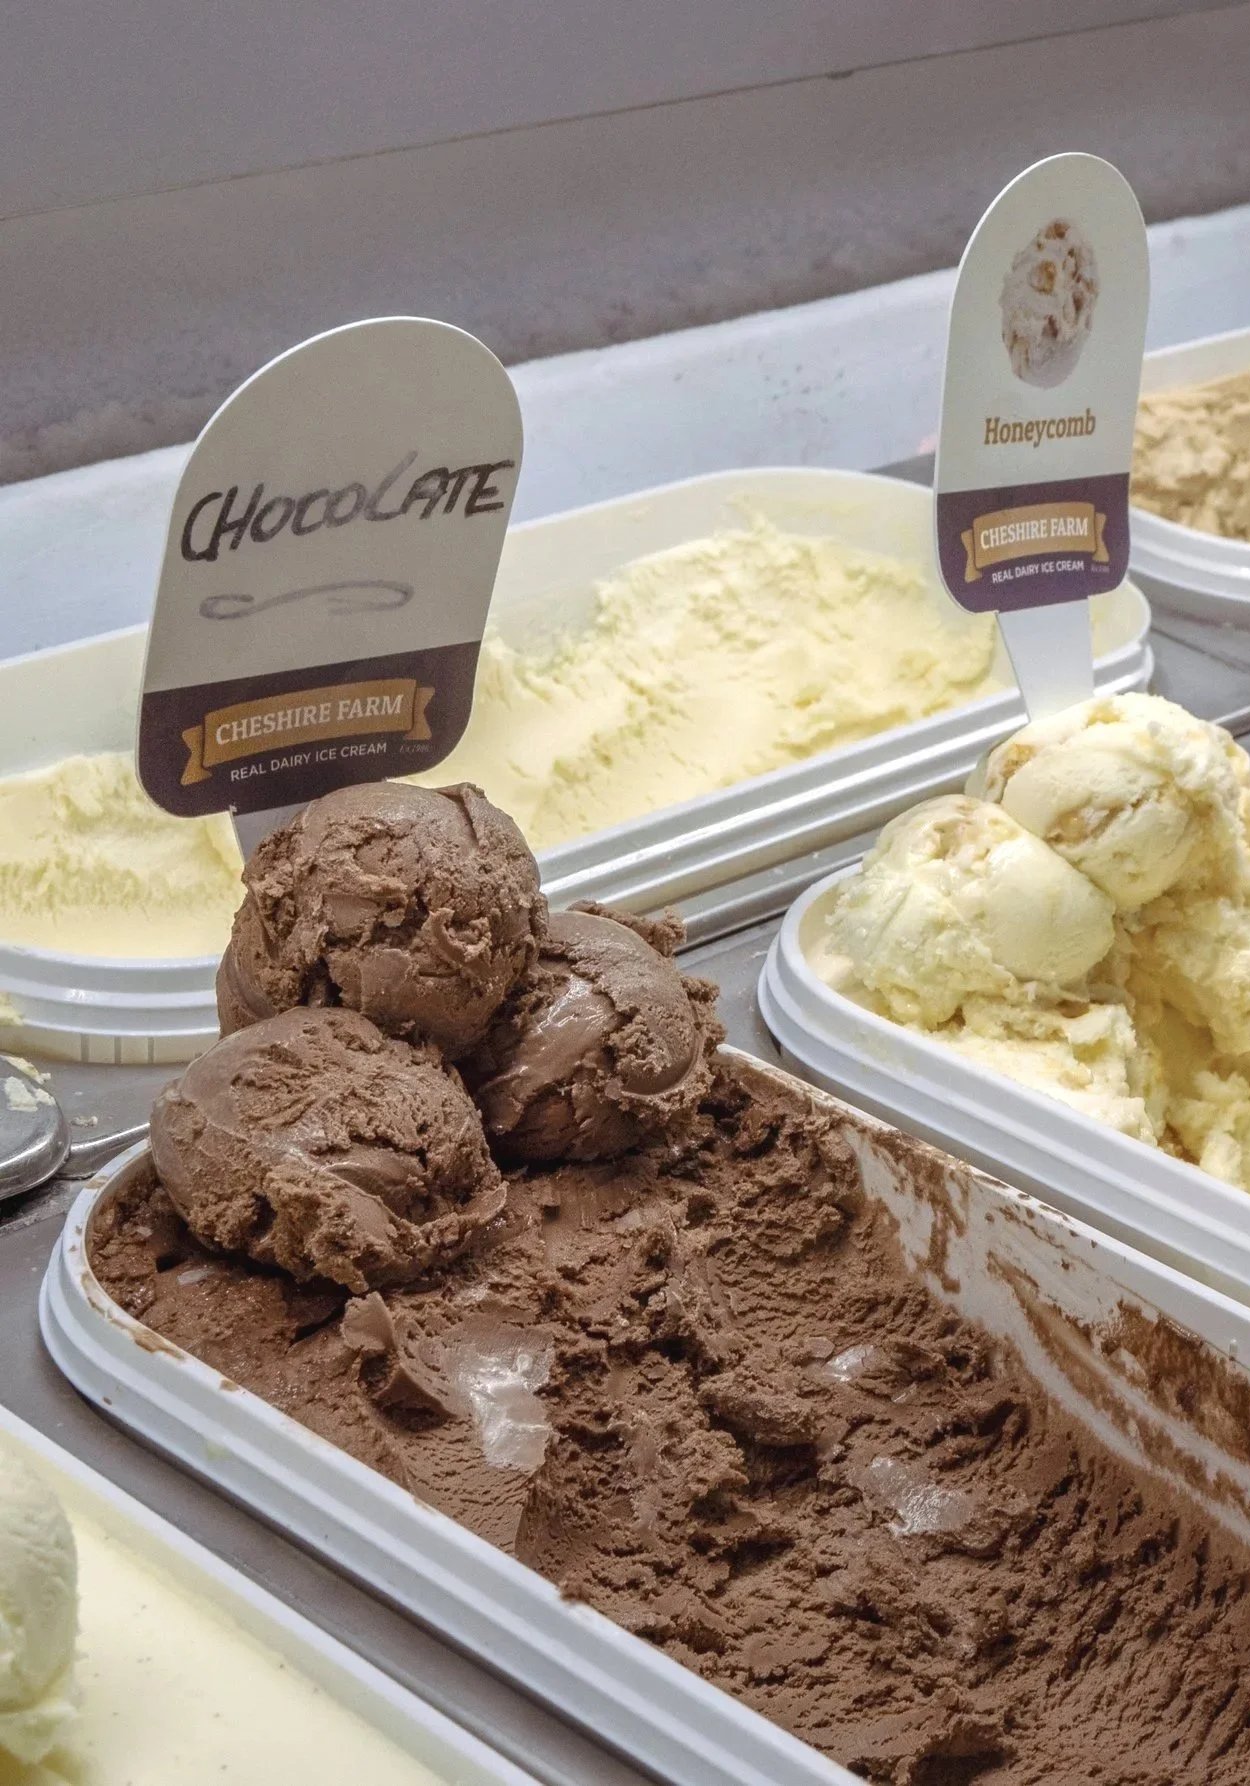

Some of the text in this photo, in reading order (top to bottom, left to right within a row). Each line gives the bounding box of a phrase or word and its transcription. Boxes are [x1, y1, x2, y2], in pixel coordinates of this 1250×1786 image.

[983, 408, 1096, 448] Honeycomb
[180, 450, 515, 562] CHOCOLATE
[980, 517, 1088, 549] CHESHIRE FARM
[992, 568, 1013, 583] REAL
[1015, 563, 1039, 578] DAIRY
[1041, 561, 1054, 573] ICE
[1056, 560, 1084, 572] CREAM
[216, 694, 404, 745] CHESHIRE FARM
[230, 763, 266, 783] REAL
[271, 752, 311, 771] DAIRY
[315, 749, 336, 762] ICE
[340, 742, 388, 758] CREAM
